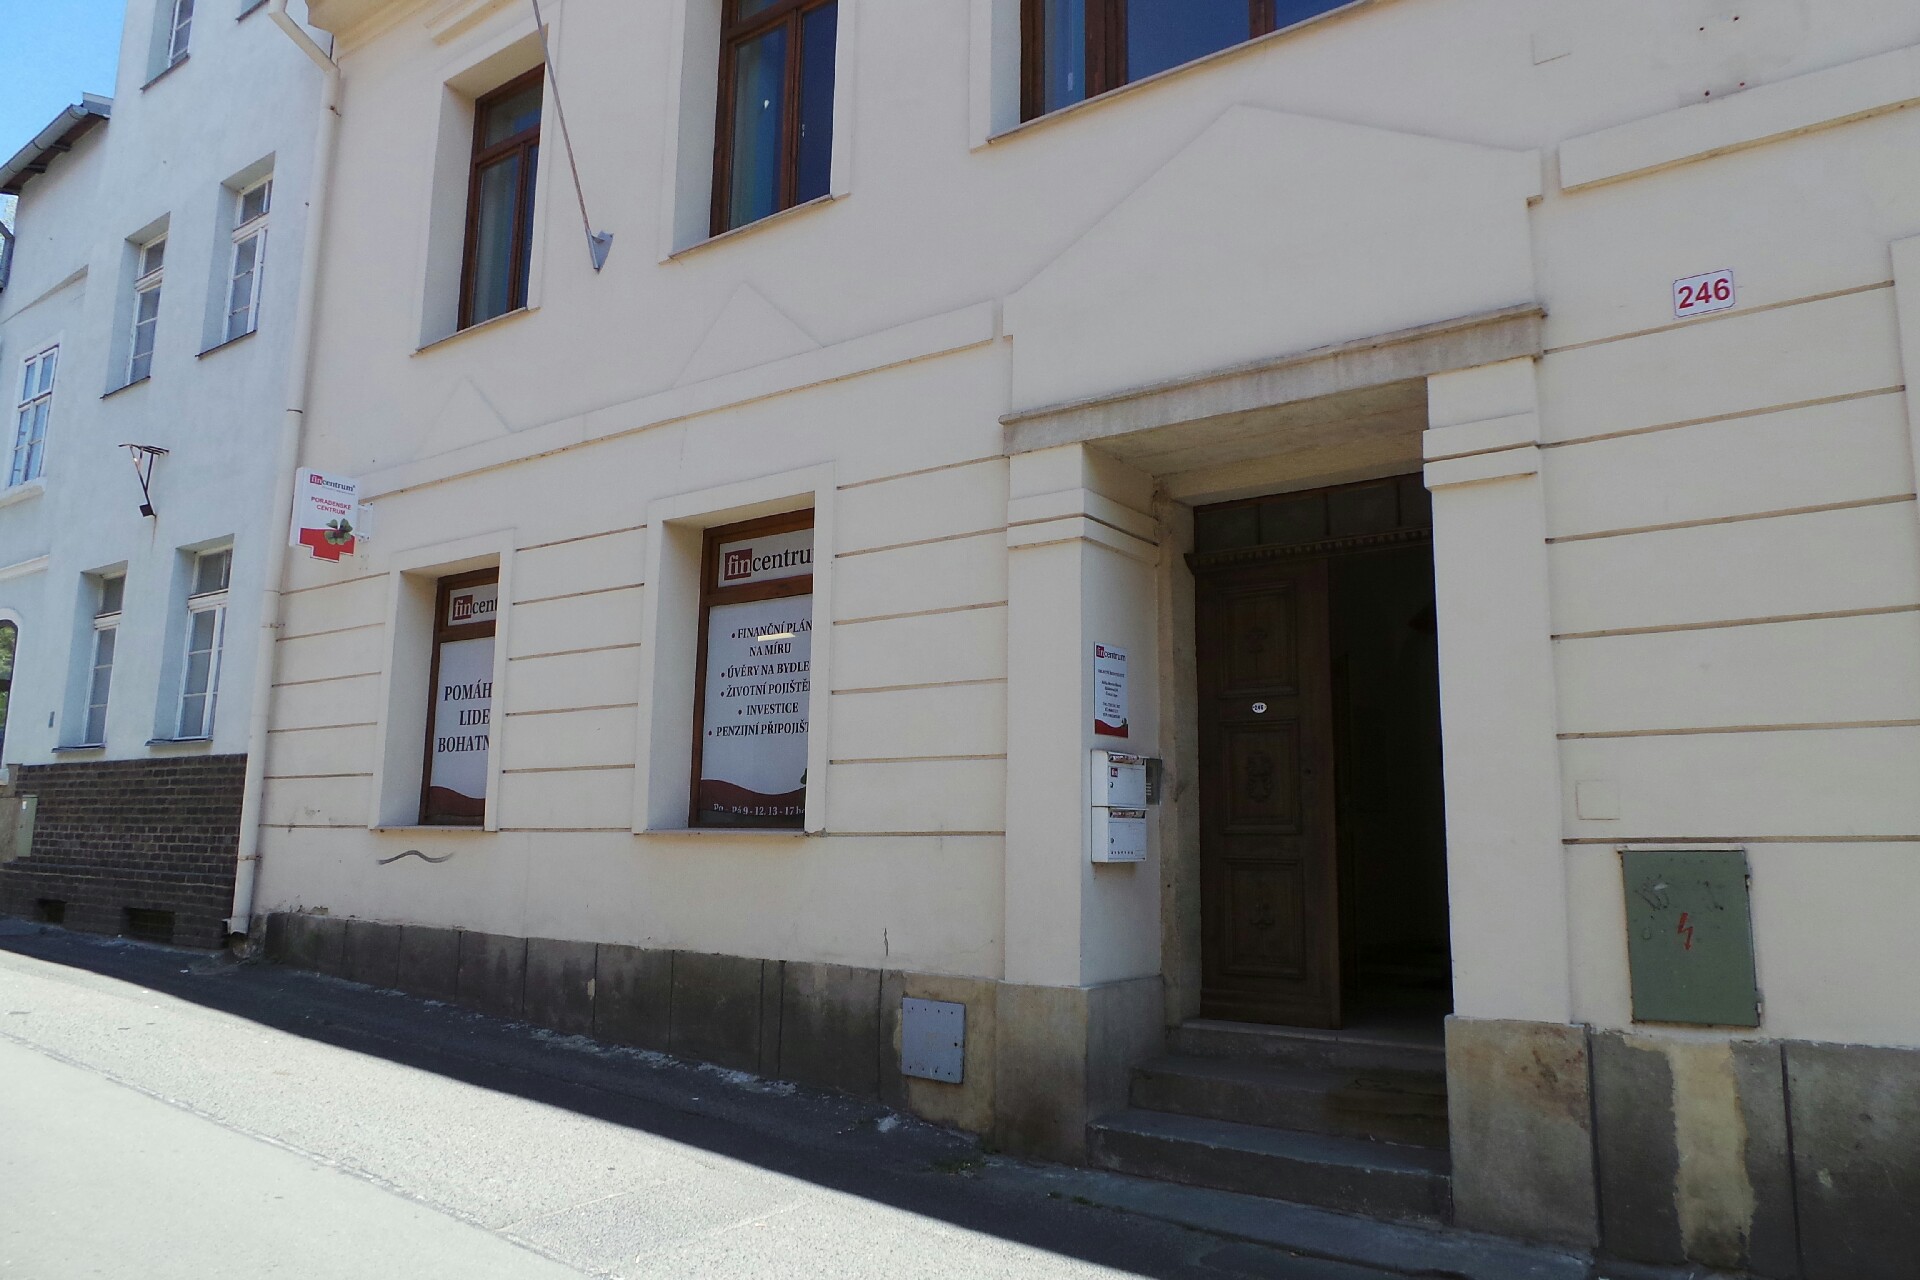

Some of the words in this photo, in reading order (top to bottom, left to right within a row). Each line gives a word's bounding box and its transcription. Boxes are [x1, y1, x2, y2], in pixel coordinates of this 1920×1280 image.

[1678, 278, 1730, 309] 246
[316, 505, 346, 516] CENTRUM
[738, 621, 785, 639] FINANČNÍ
[749, 646, 762, 657] NA
[764, 641, 791, 655] MÍRU
[727, 664, 760, 678] ÚVĚRY
[761, 664, 774, 675] NA
[444, 678, 493, 701] POMÁH
[726, 682, 767, 698] ŽIVOTNÍ
[746, 702, 799, 716] INVESTICE
[459, 709, 490, 726] LIDE
[716, 721, 759, 737] PENZIJNÍ
[768, 806, 778, 815] 13
[785, 806, 795, 815] 17
